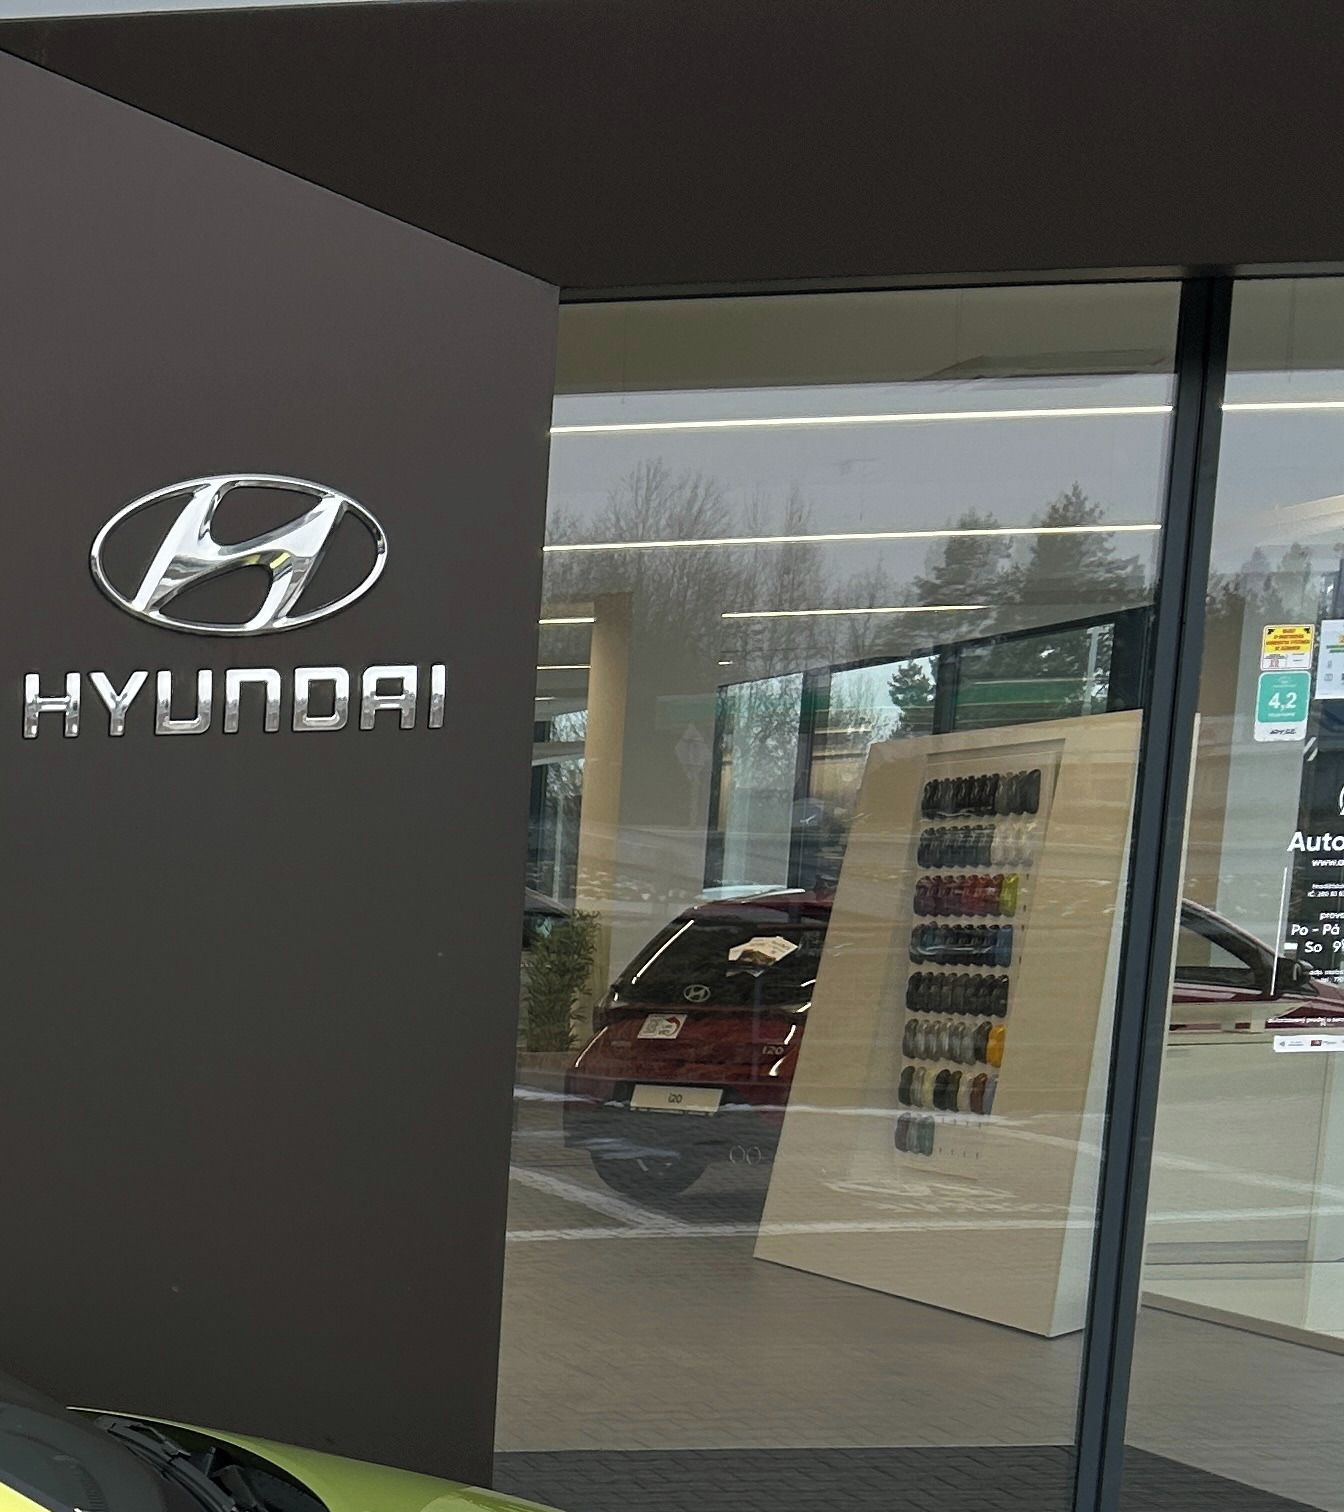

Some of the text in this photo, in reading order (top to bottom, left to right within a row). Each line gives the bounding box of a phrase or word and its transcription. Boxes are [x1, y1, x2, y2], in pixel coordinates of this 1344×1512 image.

[22, 663, 447, 739] HYUNDAI
[1291, 923, 1309, 936] Po
[1322, 923, 1340, 936] Pá
[1304, 941, 1323, 953] So
